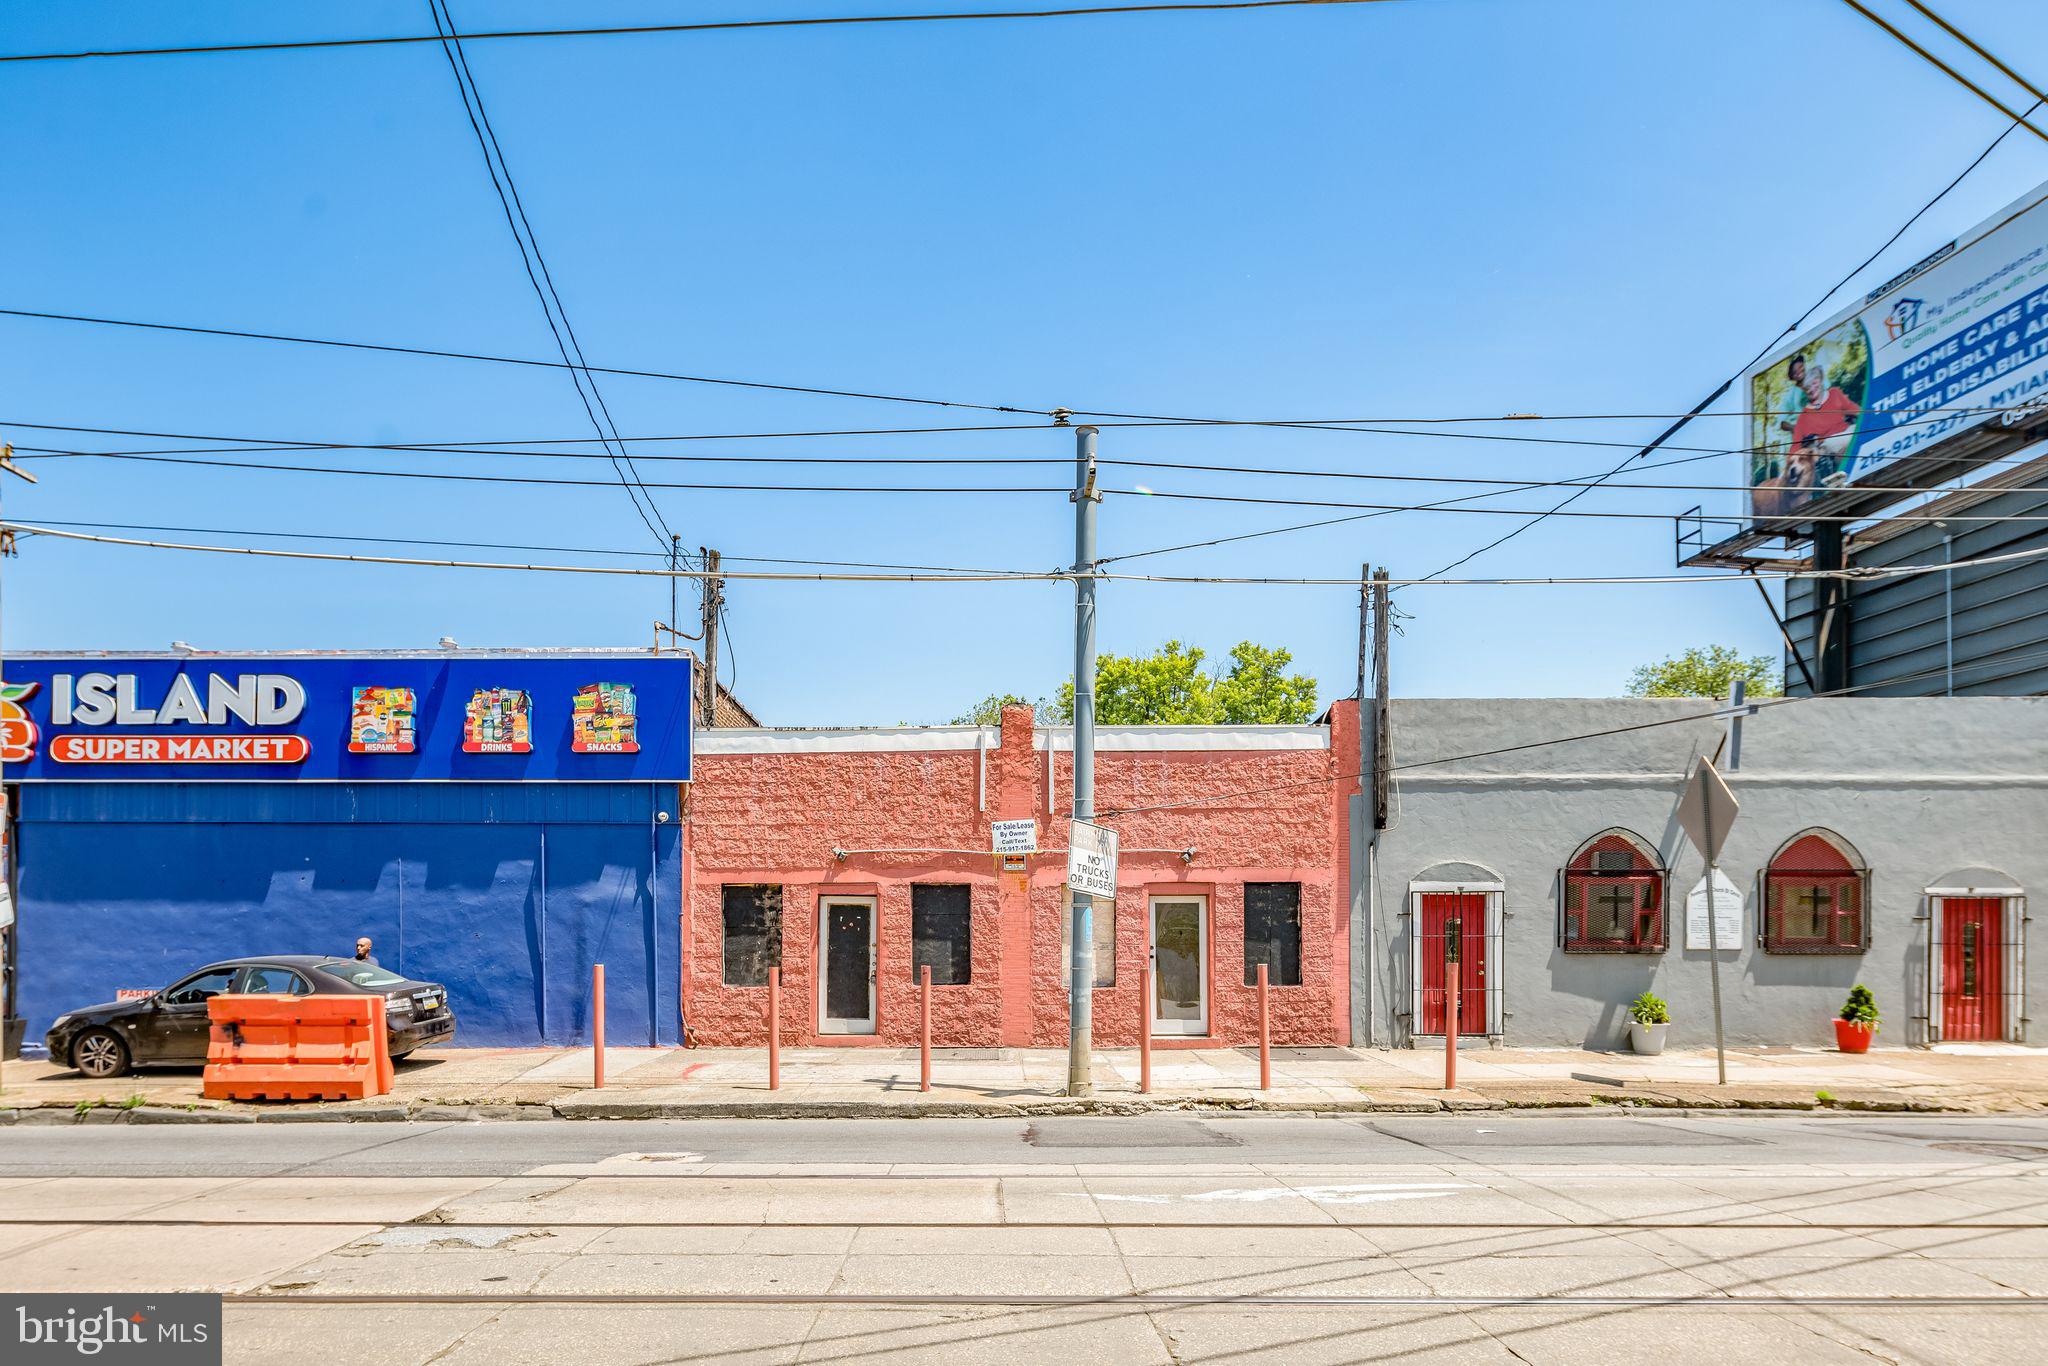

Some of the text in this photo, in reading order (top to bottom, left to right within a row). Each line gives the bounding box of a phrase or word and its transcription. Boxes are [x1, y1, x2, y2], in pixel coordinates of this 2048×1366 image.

[1902, 338, 1960, 379] HOME
[1963, 304, 2022, 347] CARE
[1872, 386, 1909, 415] THE
[1912, 339, 2000, 395] ELDERLY
[2003, 331, 2020, 349] &
[1892, 390, 1943, 426] WITH
[52, 673, 305, 726] ISLAND
[67, 738, 289, 760] SUPER MARKET
[364, 743, 398, 752] HISPANIC
[481, 743, 513, 752] DRINKS
[586, 743, 623, 752] SNACKS
[992, 823, 1002, 831] For
[999, 831, 1008, 839] By
[1087, 854, 1100, 866] NO
[1076, 863, 1109, 880] TRUCKS
[1070, 873, 1114, 892] OR BUSES
